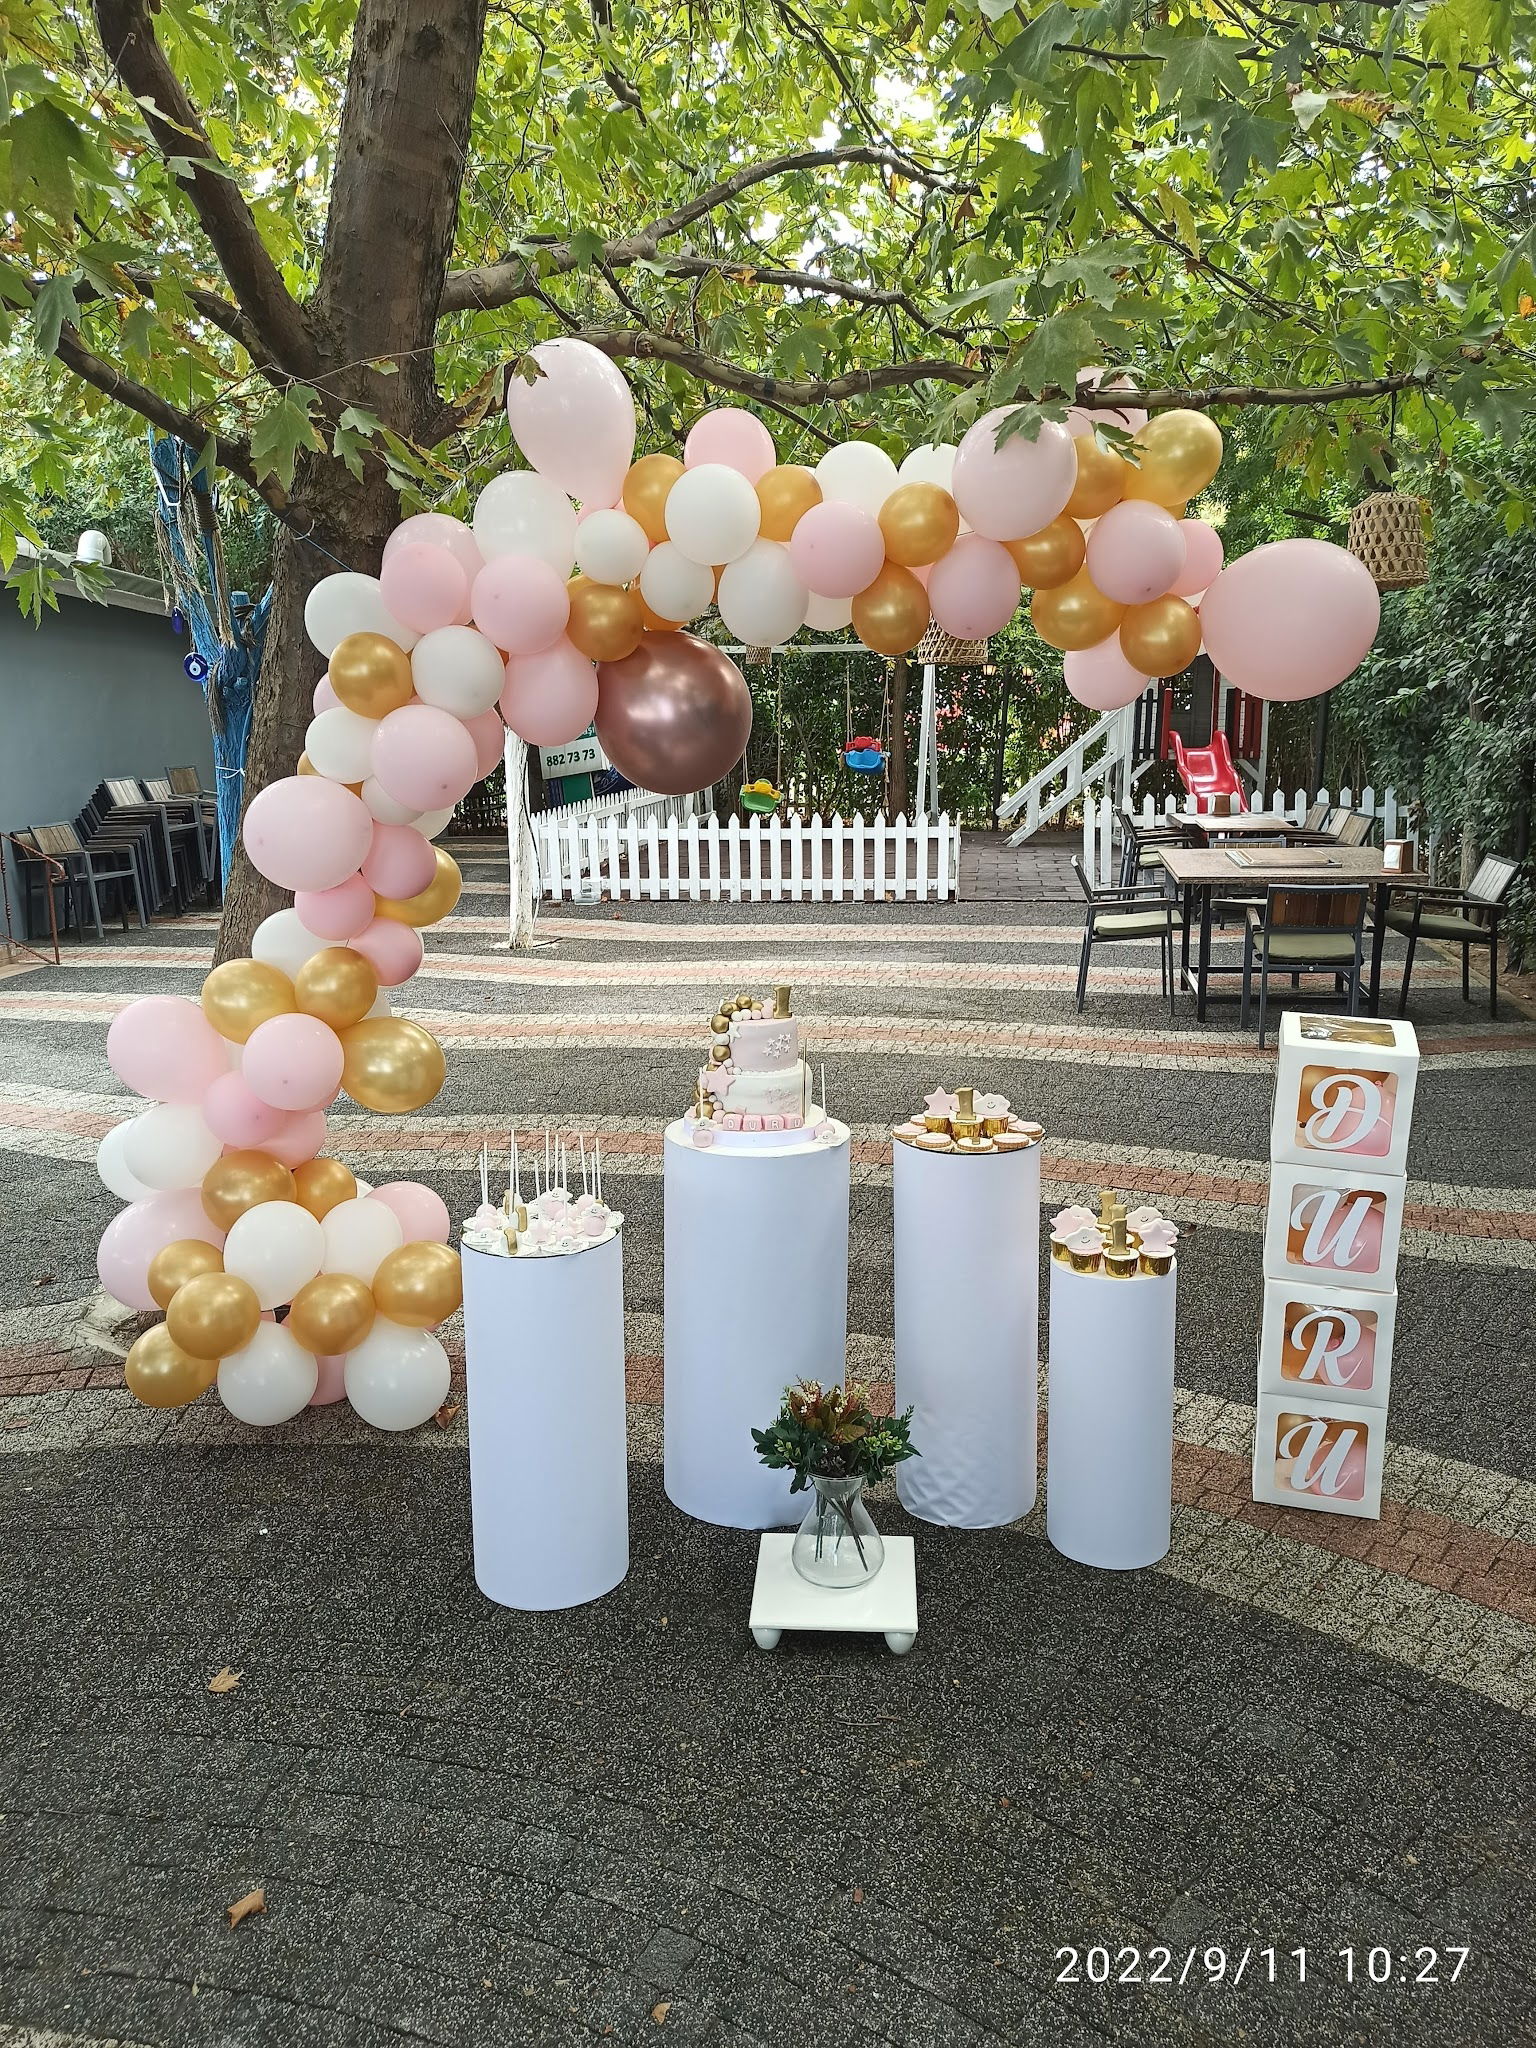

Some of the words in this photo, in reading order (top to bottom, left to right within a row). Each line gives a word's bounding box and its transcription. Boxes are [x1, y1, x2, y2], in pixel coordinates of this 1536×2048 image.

[547, 755, 566, 767] 882
[567, 751, 580, 763] 73
[583, 749, 596, 761] 73
